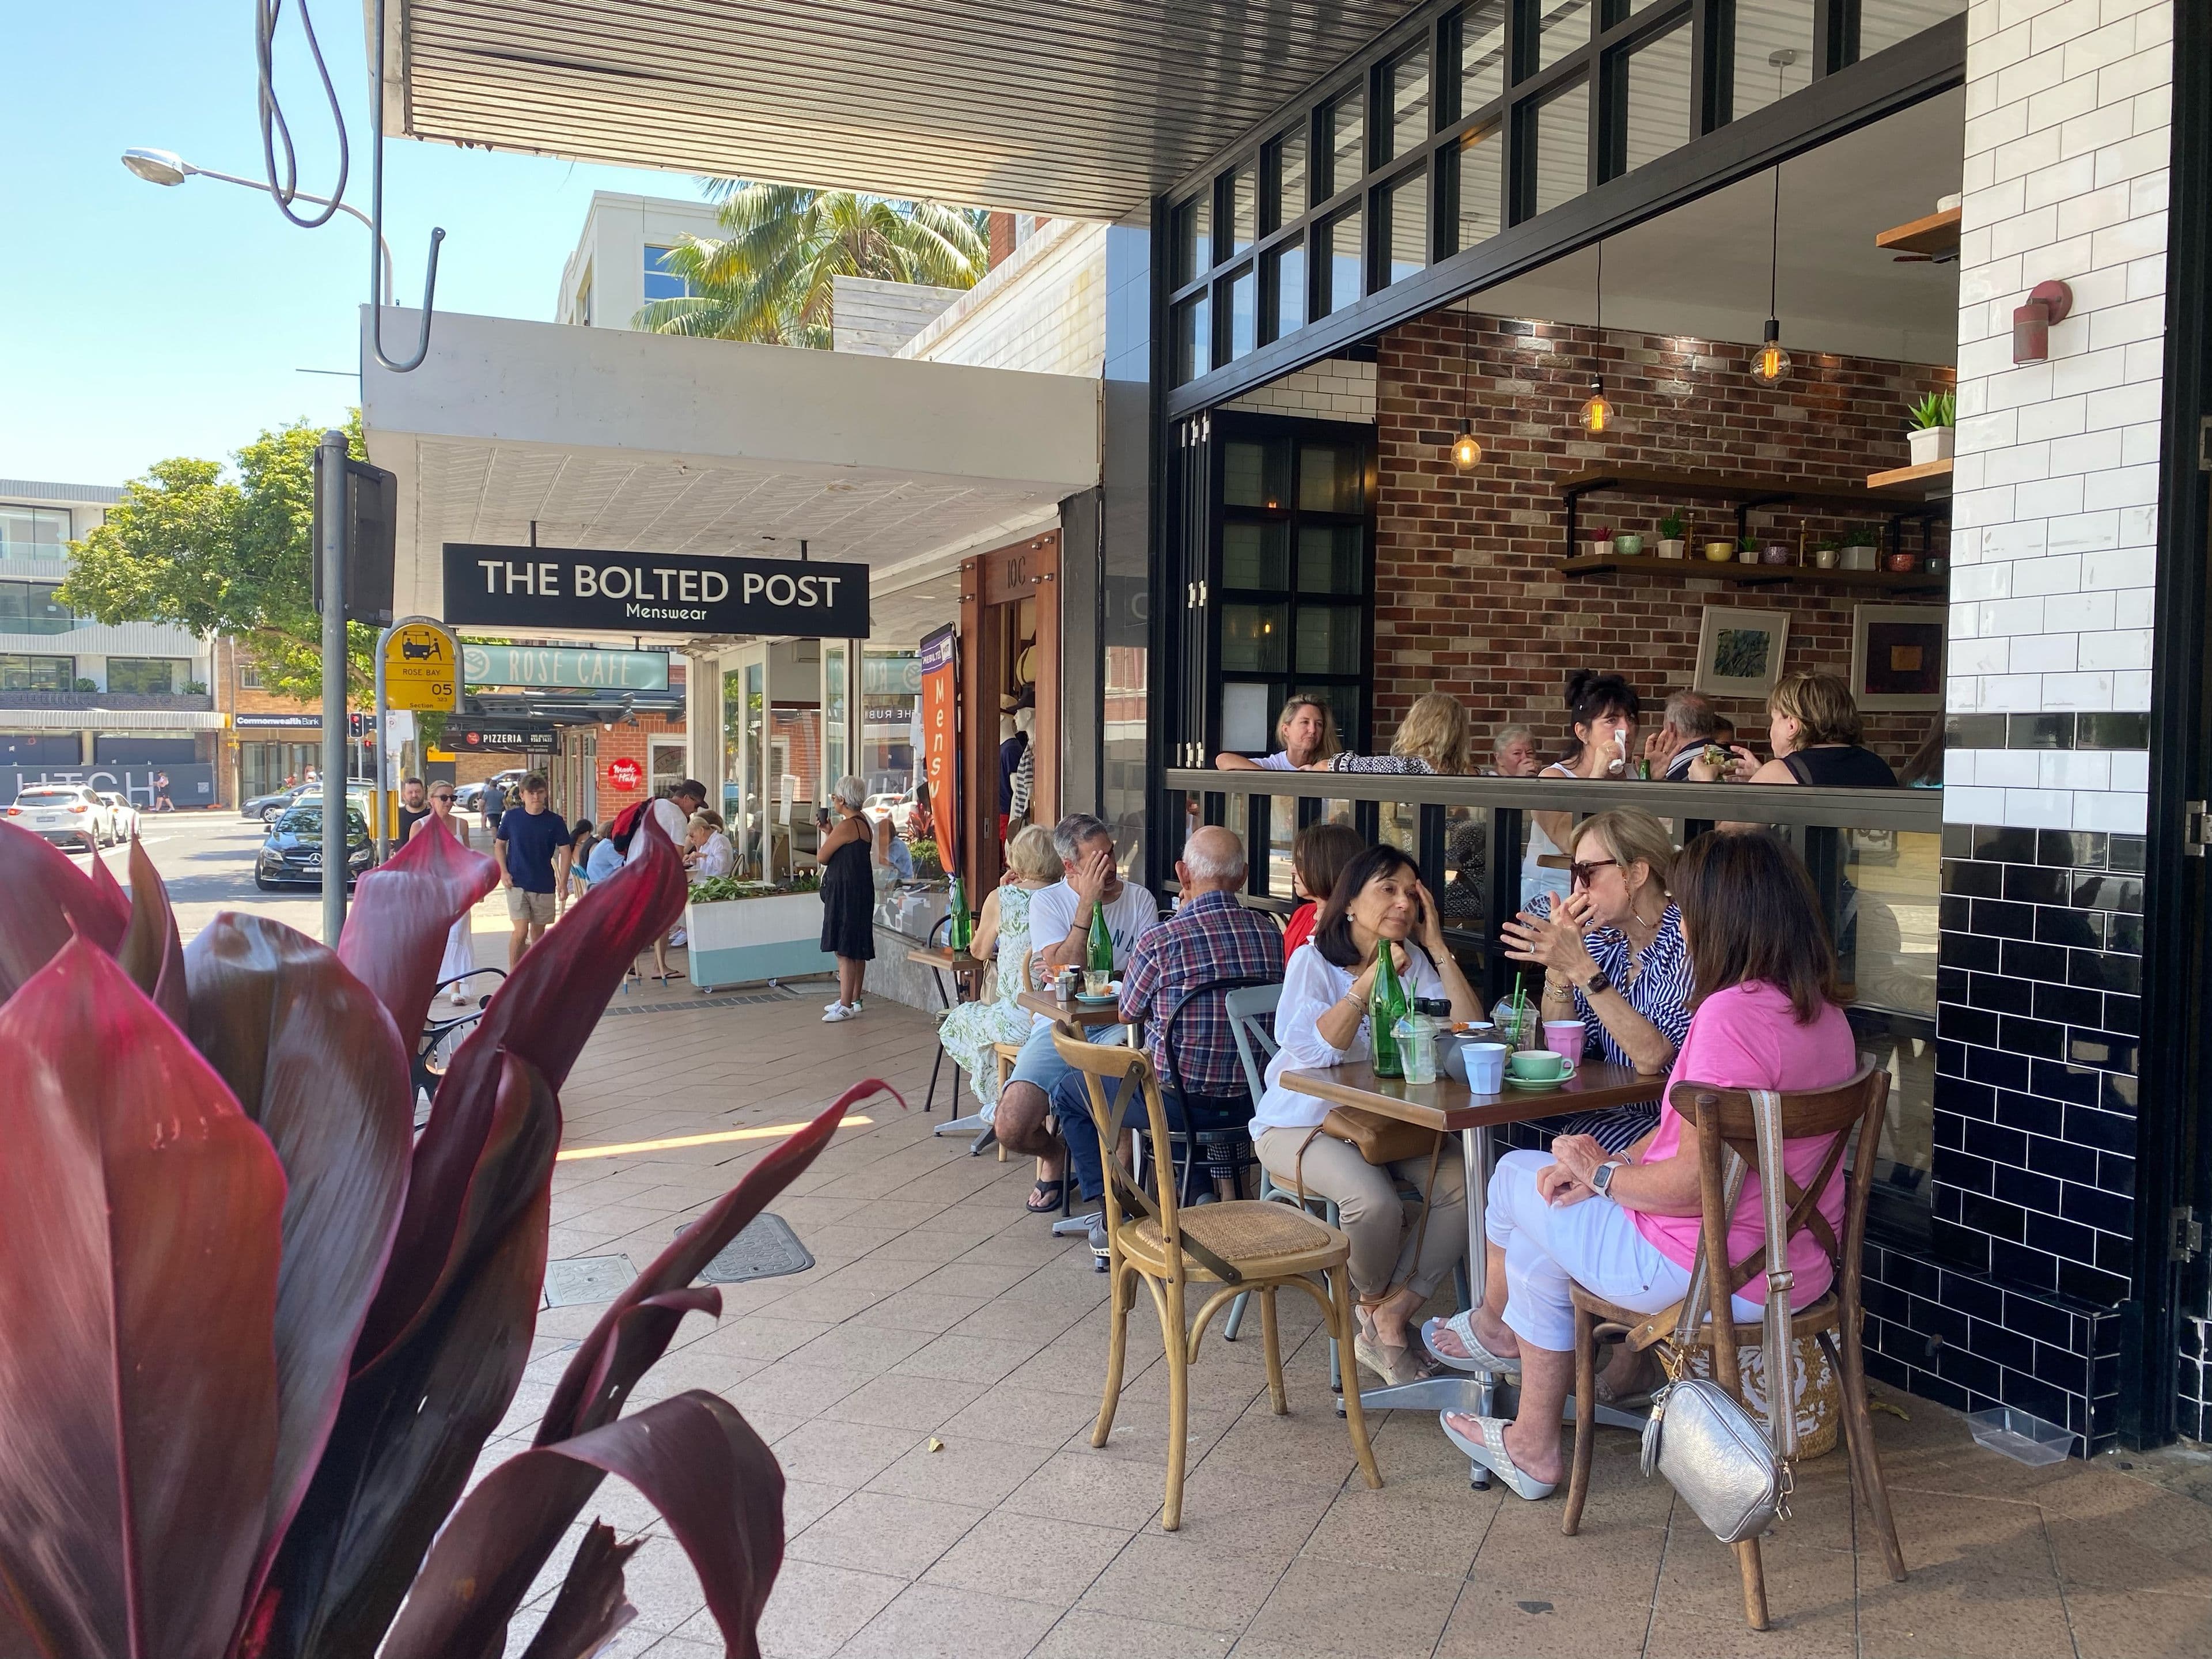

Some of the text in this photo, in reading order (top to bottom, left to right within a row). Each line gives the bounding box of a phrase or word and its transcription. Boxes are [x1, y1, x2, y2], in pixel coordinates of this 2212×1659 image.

[478, 559, 841, 608] THE BOLTED POST
[626, 603, 707, 621] Menswear
[509, 649, 631, 686] ROSE CAFE
[432, 684, 452, 695] 05
[237, 717, 301, 725] Commonwealth
[483, 734, 522, 743] PIZZERIA
[613, 763, 637, 774] Made
[618, 773, 637, 789] Italy
